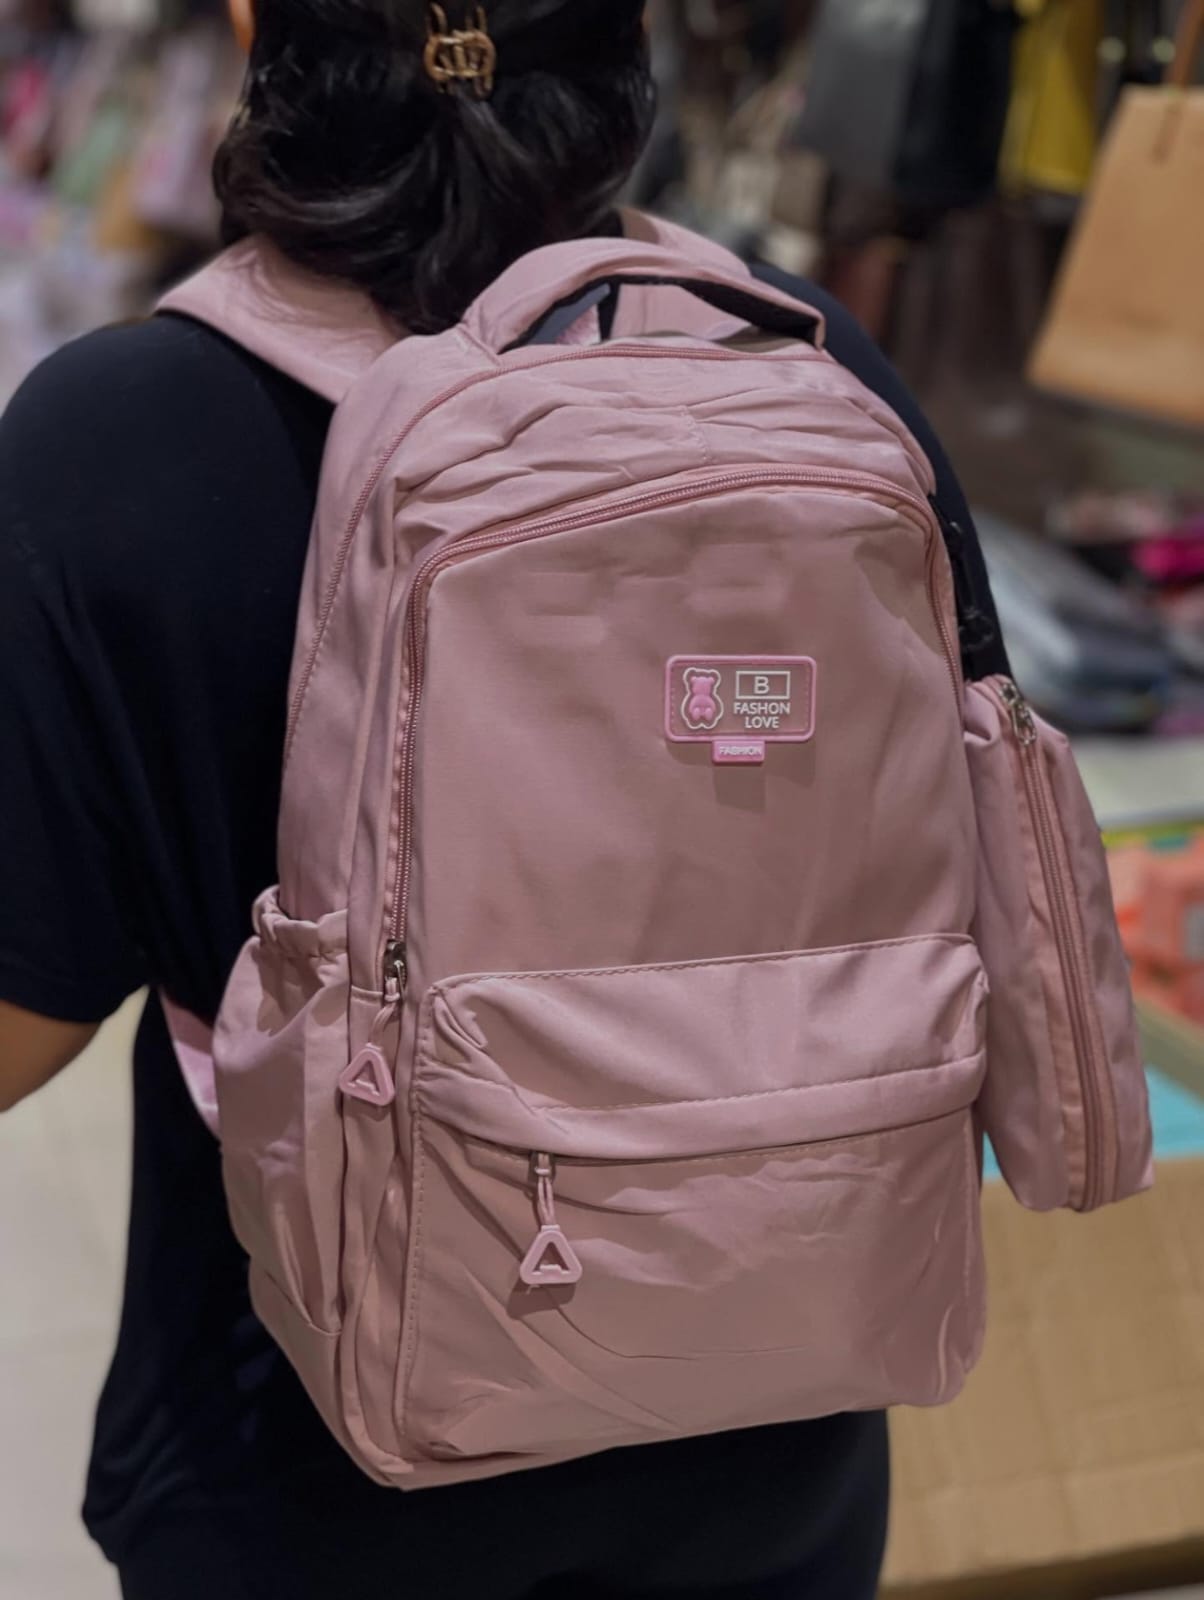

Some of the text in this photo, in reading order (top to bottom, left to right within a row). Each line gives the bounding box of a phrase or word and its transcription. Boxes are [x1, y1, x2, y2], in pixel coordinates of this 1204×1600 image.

[754, 676, 770, 694] B
[733, 702, 791, 715] FASHON
[744, 716, 780, 729] LOVE
